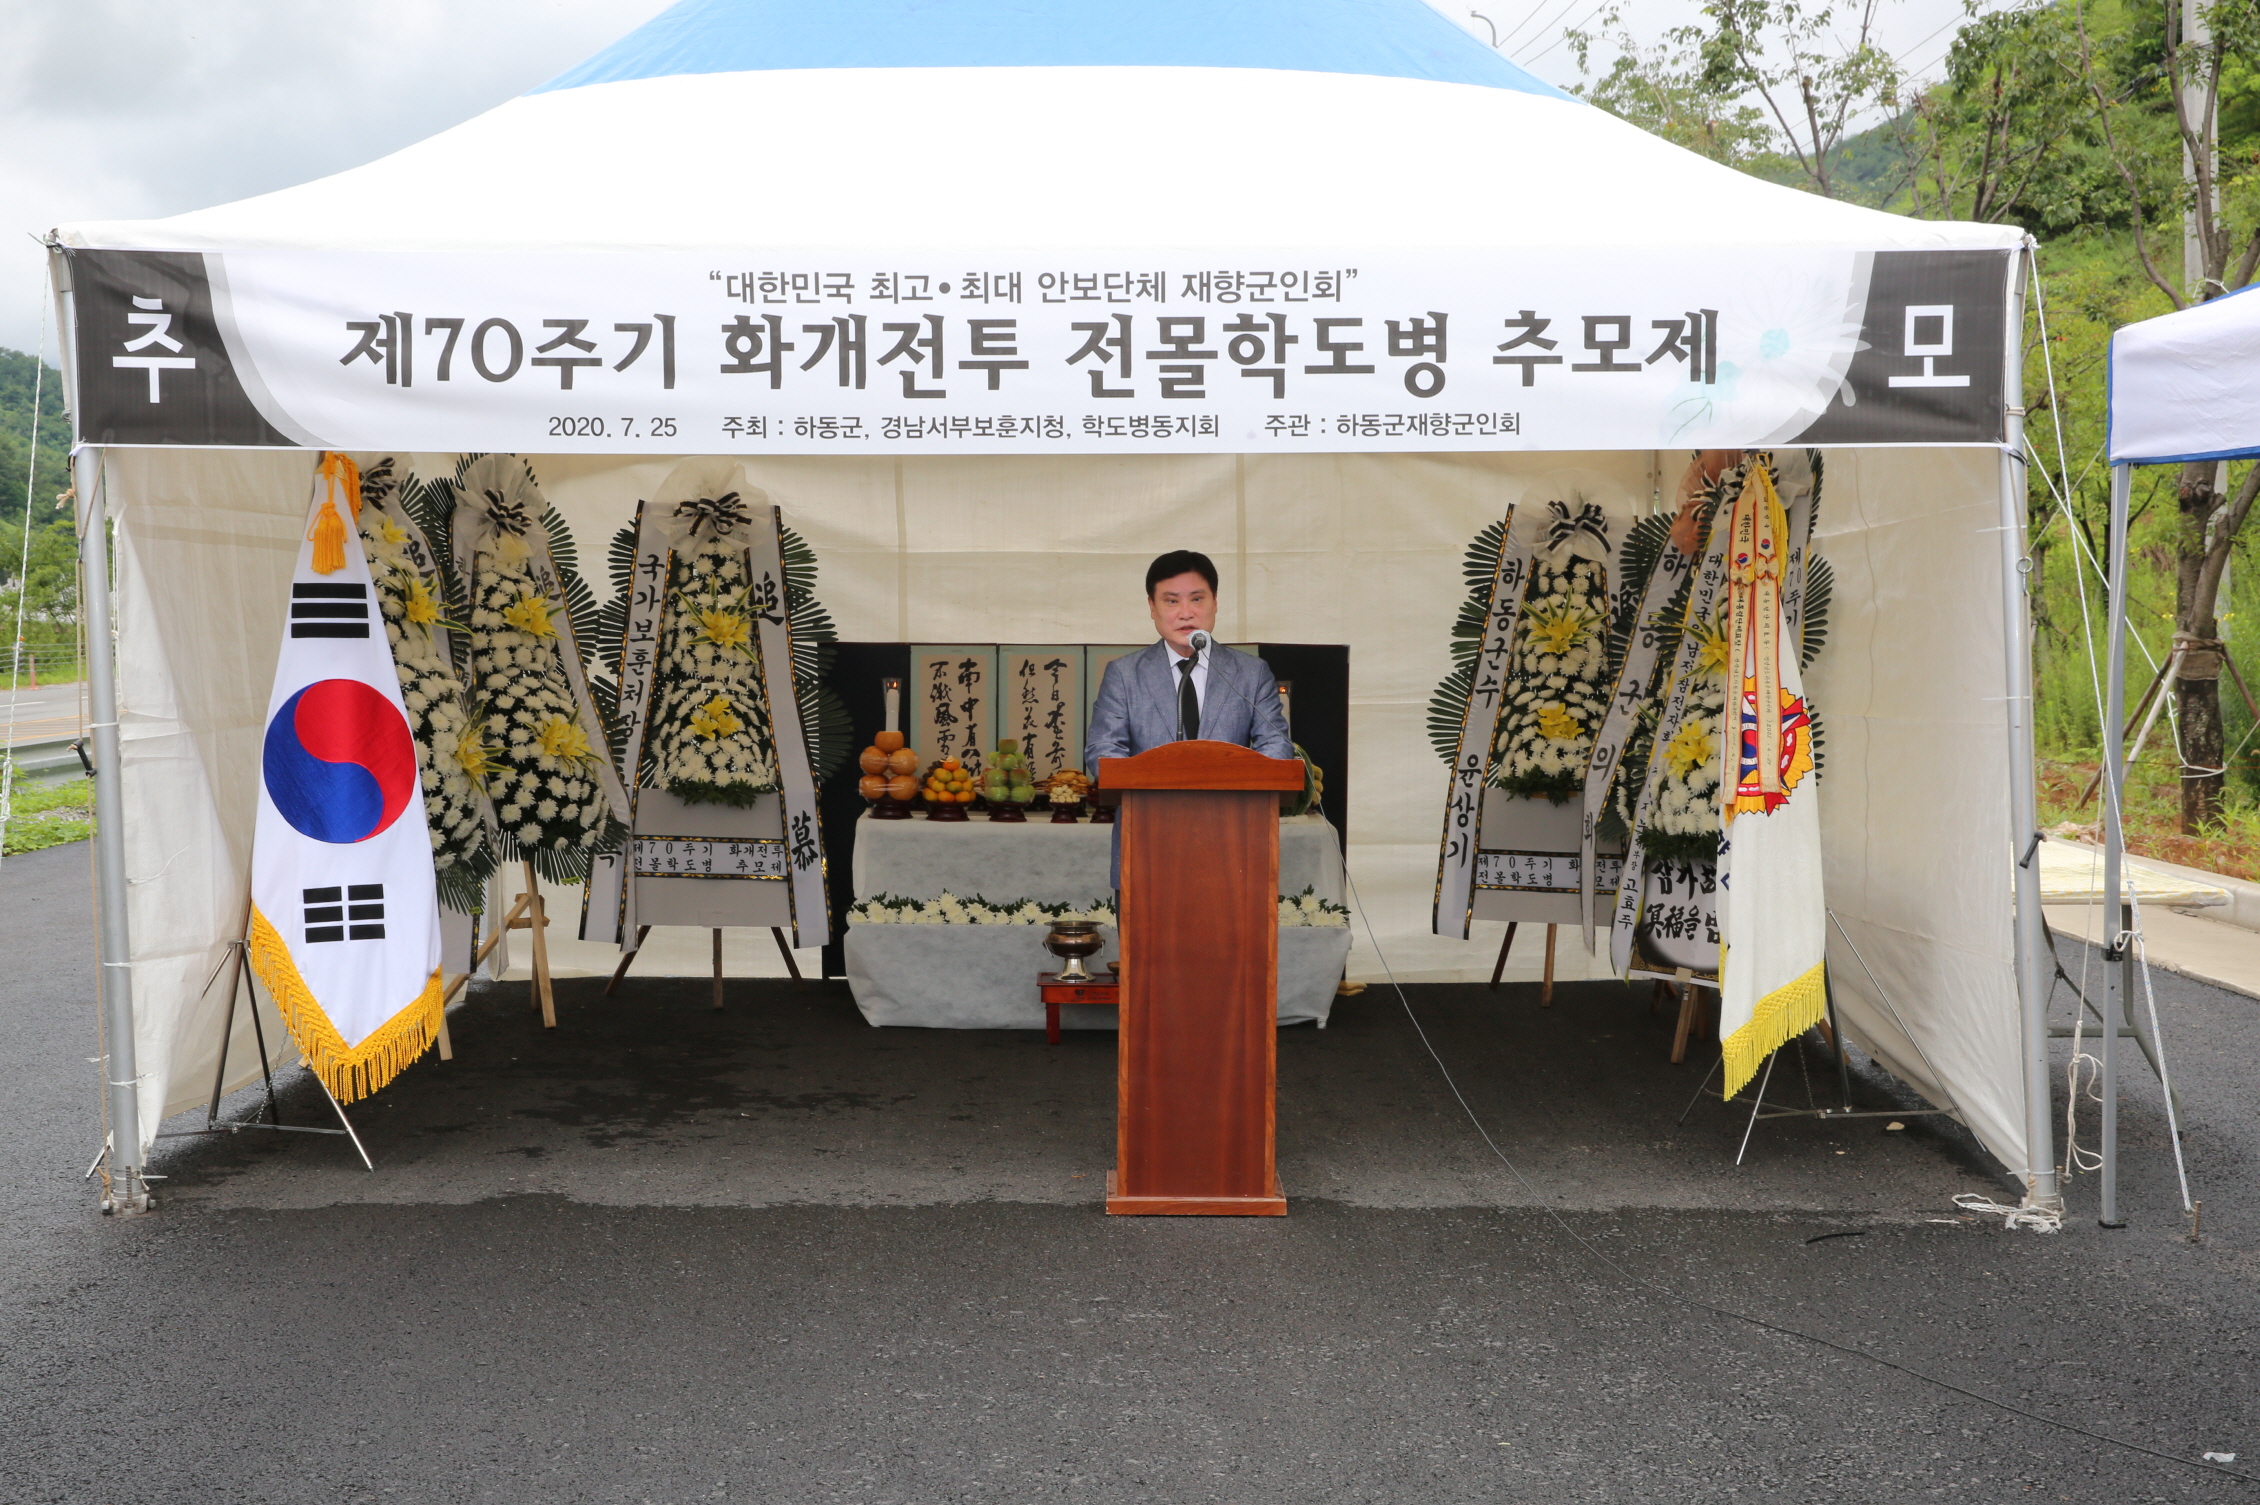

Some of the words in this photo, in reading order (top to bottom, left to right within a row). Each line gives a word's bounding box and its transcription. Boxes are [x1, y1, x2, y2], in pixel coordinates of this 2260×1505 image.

[1039, 272, 1167, 304] 안보단체
[113, 295, 196, 405] 추
[340, 312, 677, 391] 제70주기
[721, 313, 1030, 400] 화개전투
[1066, 312, 1449, 400] 전몰학도병
[1493, 309, 1719, 388] 추모제
[1889, 304, 1972, 389] 모
[723, 417, 768, 440] 주최
[795, 417, 870, 441] 하동군,
[882, 416, 1072, 440] 경남서부보훈지청,
[1083, 415, 1220, 439] 학도병동지회
[1265, 415, 1312, 438] 주관
[1338, 413, 1521, 438] 하동군재향군인회
[622, 553, 666, 738] 국가보훈처장
[1474, 557, 1526, 709] 하동군수
[1446, 753, 1483, 869] 윤상기
[728, 843, 784, 857] 화개전투
[735, 858, 782, 874] 추모제
[1477, 855, 1553, 871] 제70주기
[1568, 857, 1622, 873] 화전투
[1477, 870, 1553, 886] 전몰학도병
[1575, 873, 1620, 888] 모제
[1617, 877, 1639, 930] 고효주
